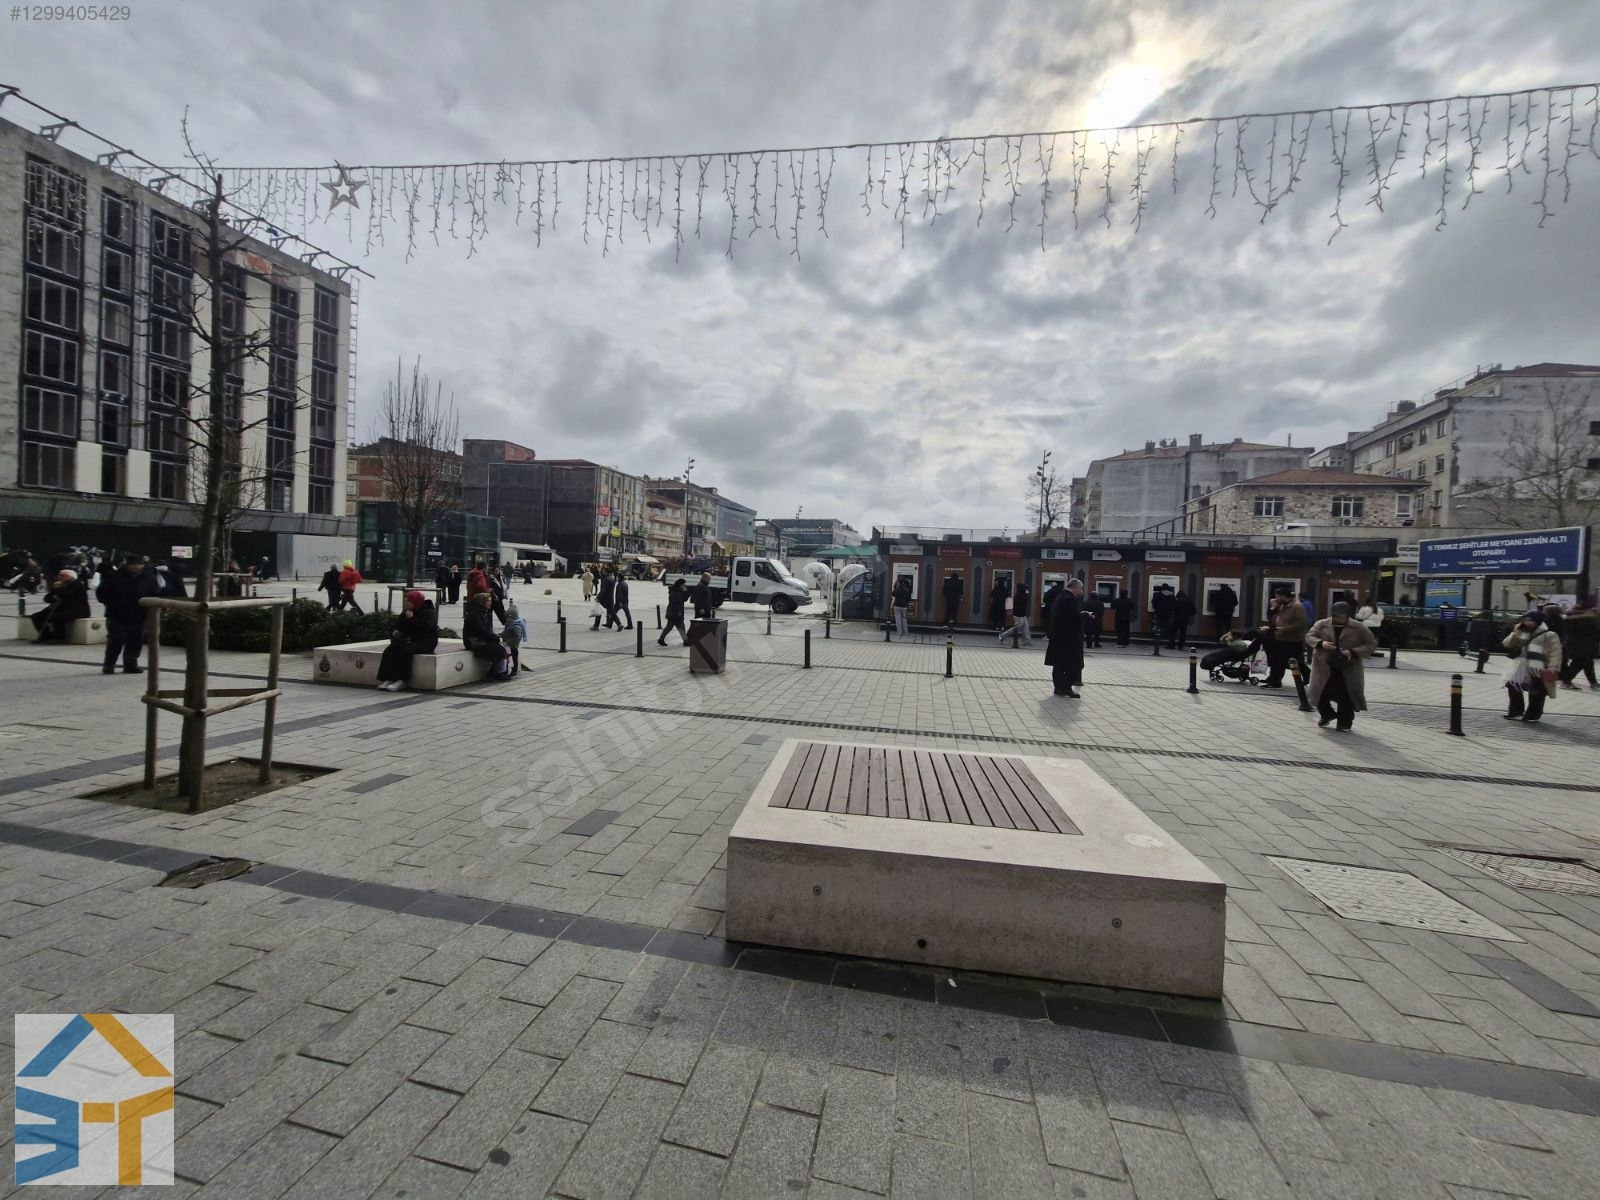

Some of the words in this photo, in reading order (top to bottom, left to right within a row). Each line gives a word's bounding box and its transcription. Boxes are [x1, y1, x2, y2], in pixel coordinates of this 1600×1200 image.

[1489, 538, 1522, 547] MEYDANI
[1523, 536, 1548, 545] ZEMİN
[1549, 535, 1568, 543] ALTI
[1472, 548, 1506, 557] OTOPARKI
